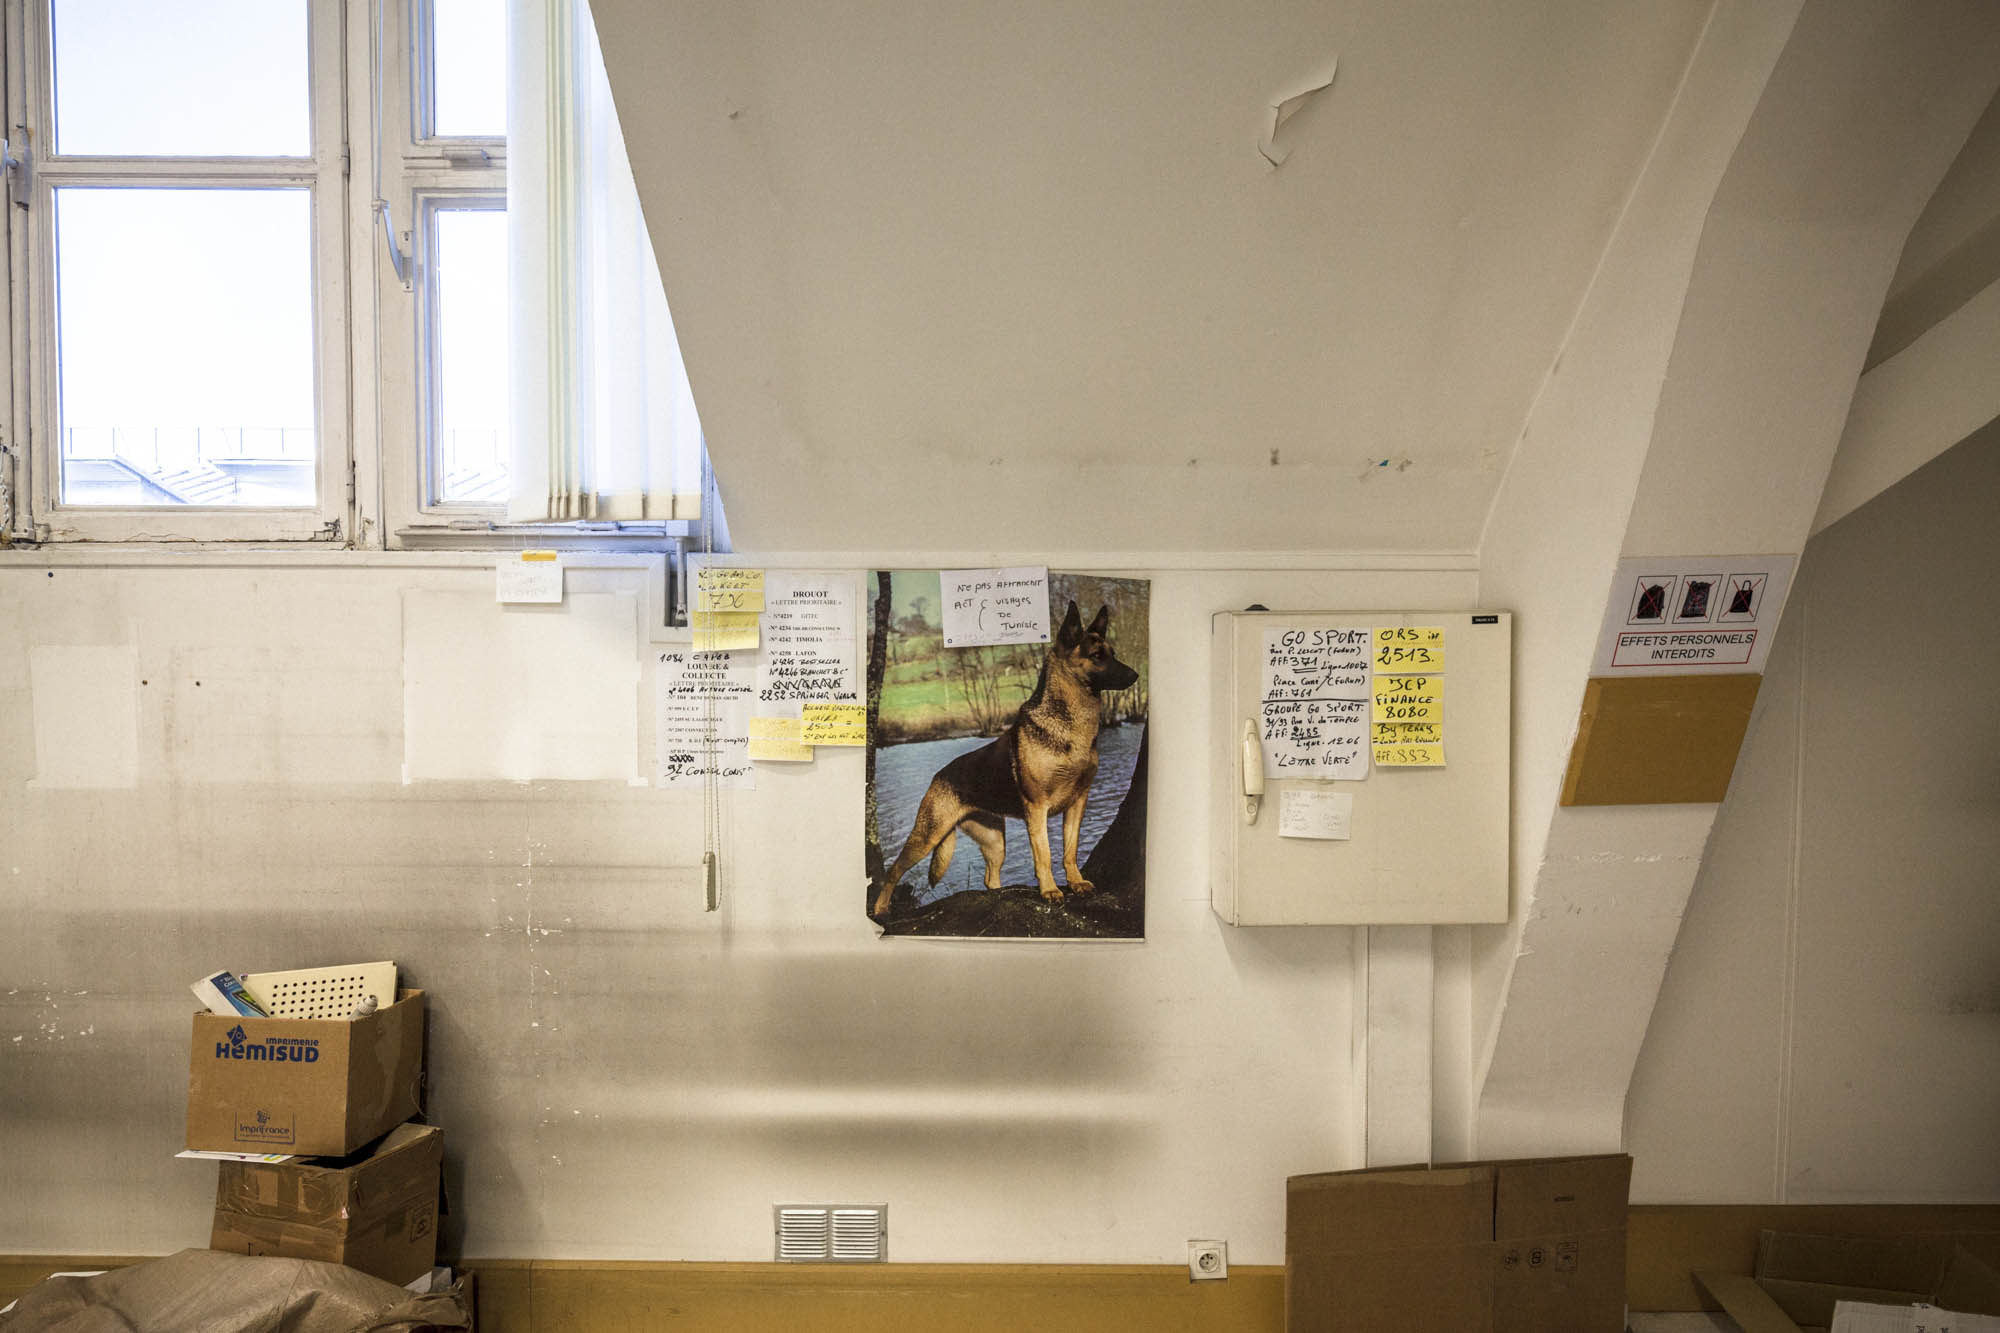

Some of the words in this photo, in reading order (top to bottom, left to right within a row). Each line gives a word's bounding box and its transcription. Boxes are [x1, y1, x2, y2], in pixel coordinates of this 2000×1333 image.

[1282, 631, 1305, 646] GO
[1381, 628, 1419, 640] ORS
[1621, 636, 1667, 646] EFFETS
[1670, 634, 1754, 645] PERSONNELS
[1651, 648, 1715, 659] INTERDITS
[760, 690, 786, 701] 2252
